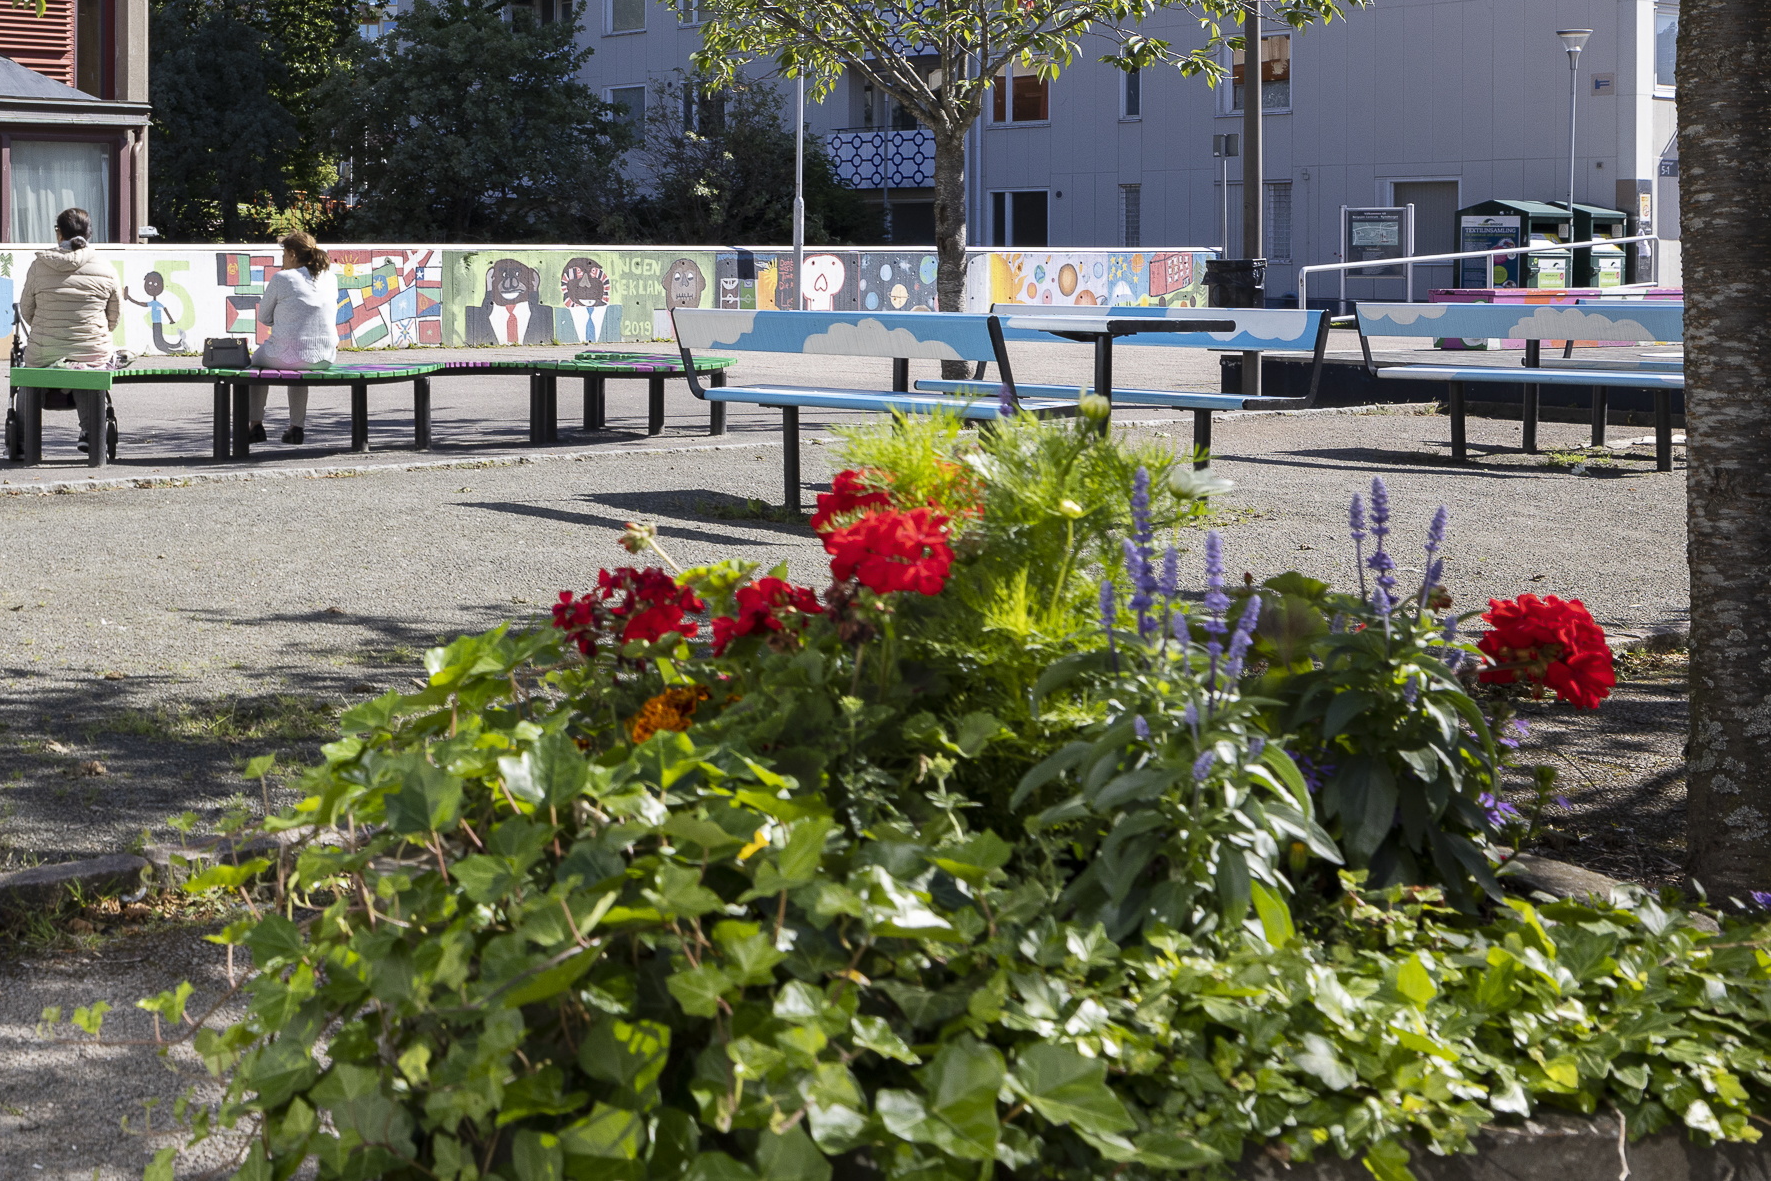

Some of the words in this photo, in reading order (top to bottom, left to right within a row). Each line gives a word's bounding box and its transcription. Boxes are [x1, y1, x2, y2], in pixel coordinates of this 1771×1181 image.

[607, 257, 662, 276] INGEN
[611, 279, 666, 296] REKLAM
[624, 320, 652, 336] 2019
